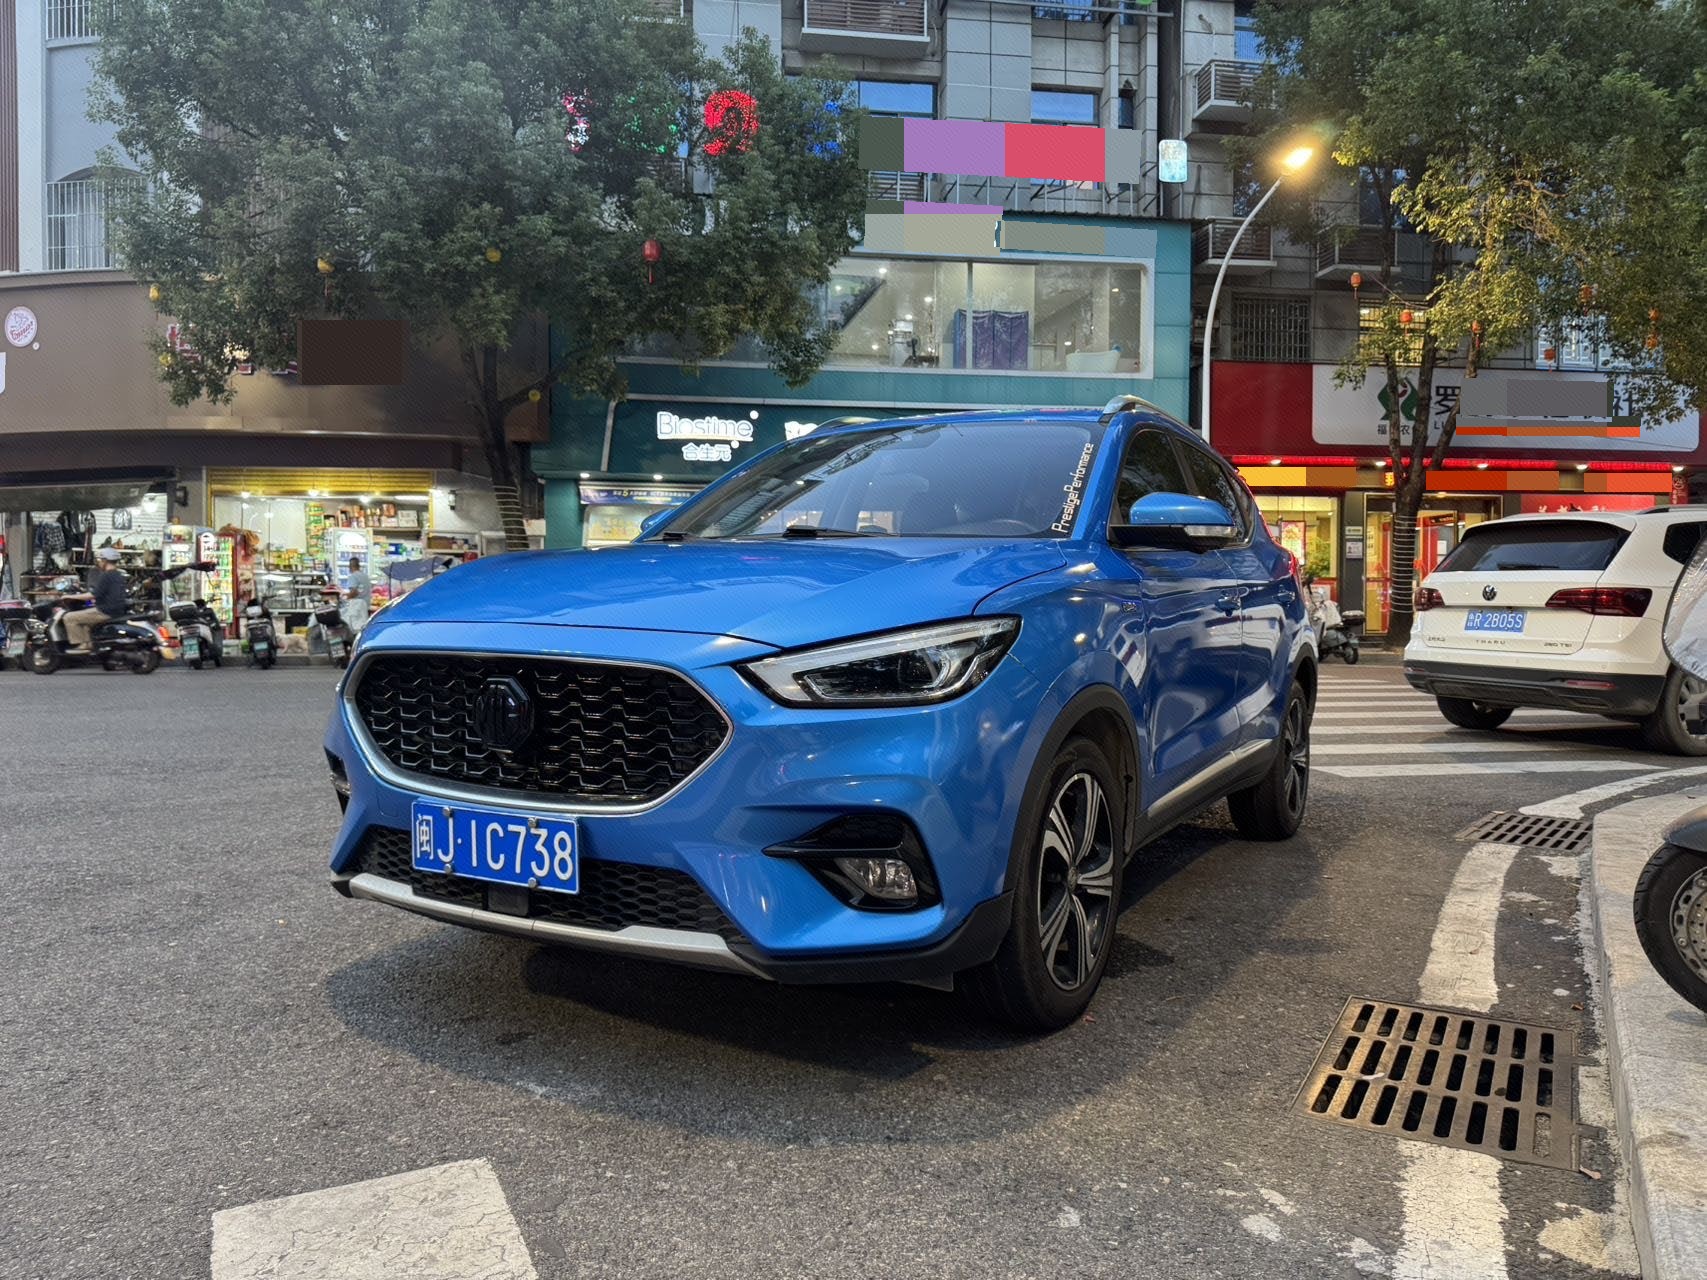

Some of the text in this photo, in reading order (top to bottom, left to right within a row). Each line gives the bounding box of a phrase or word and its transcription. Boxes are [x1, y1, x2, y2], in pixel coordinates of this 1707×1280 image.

[657, 411, 753, 439] Biostime
[682, 442, 732, 462] 合生元
